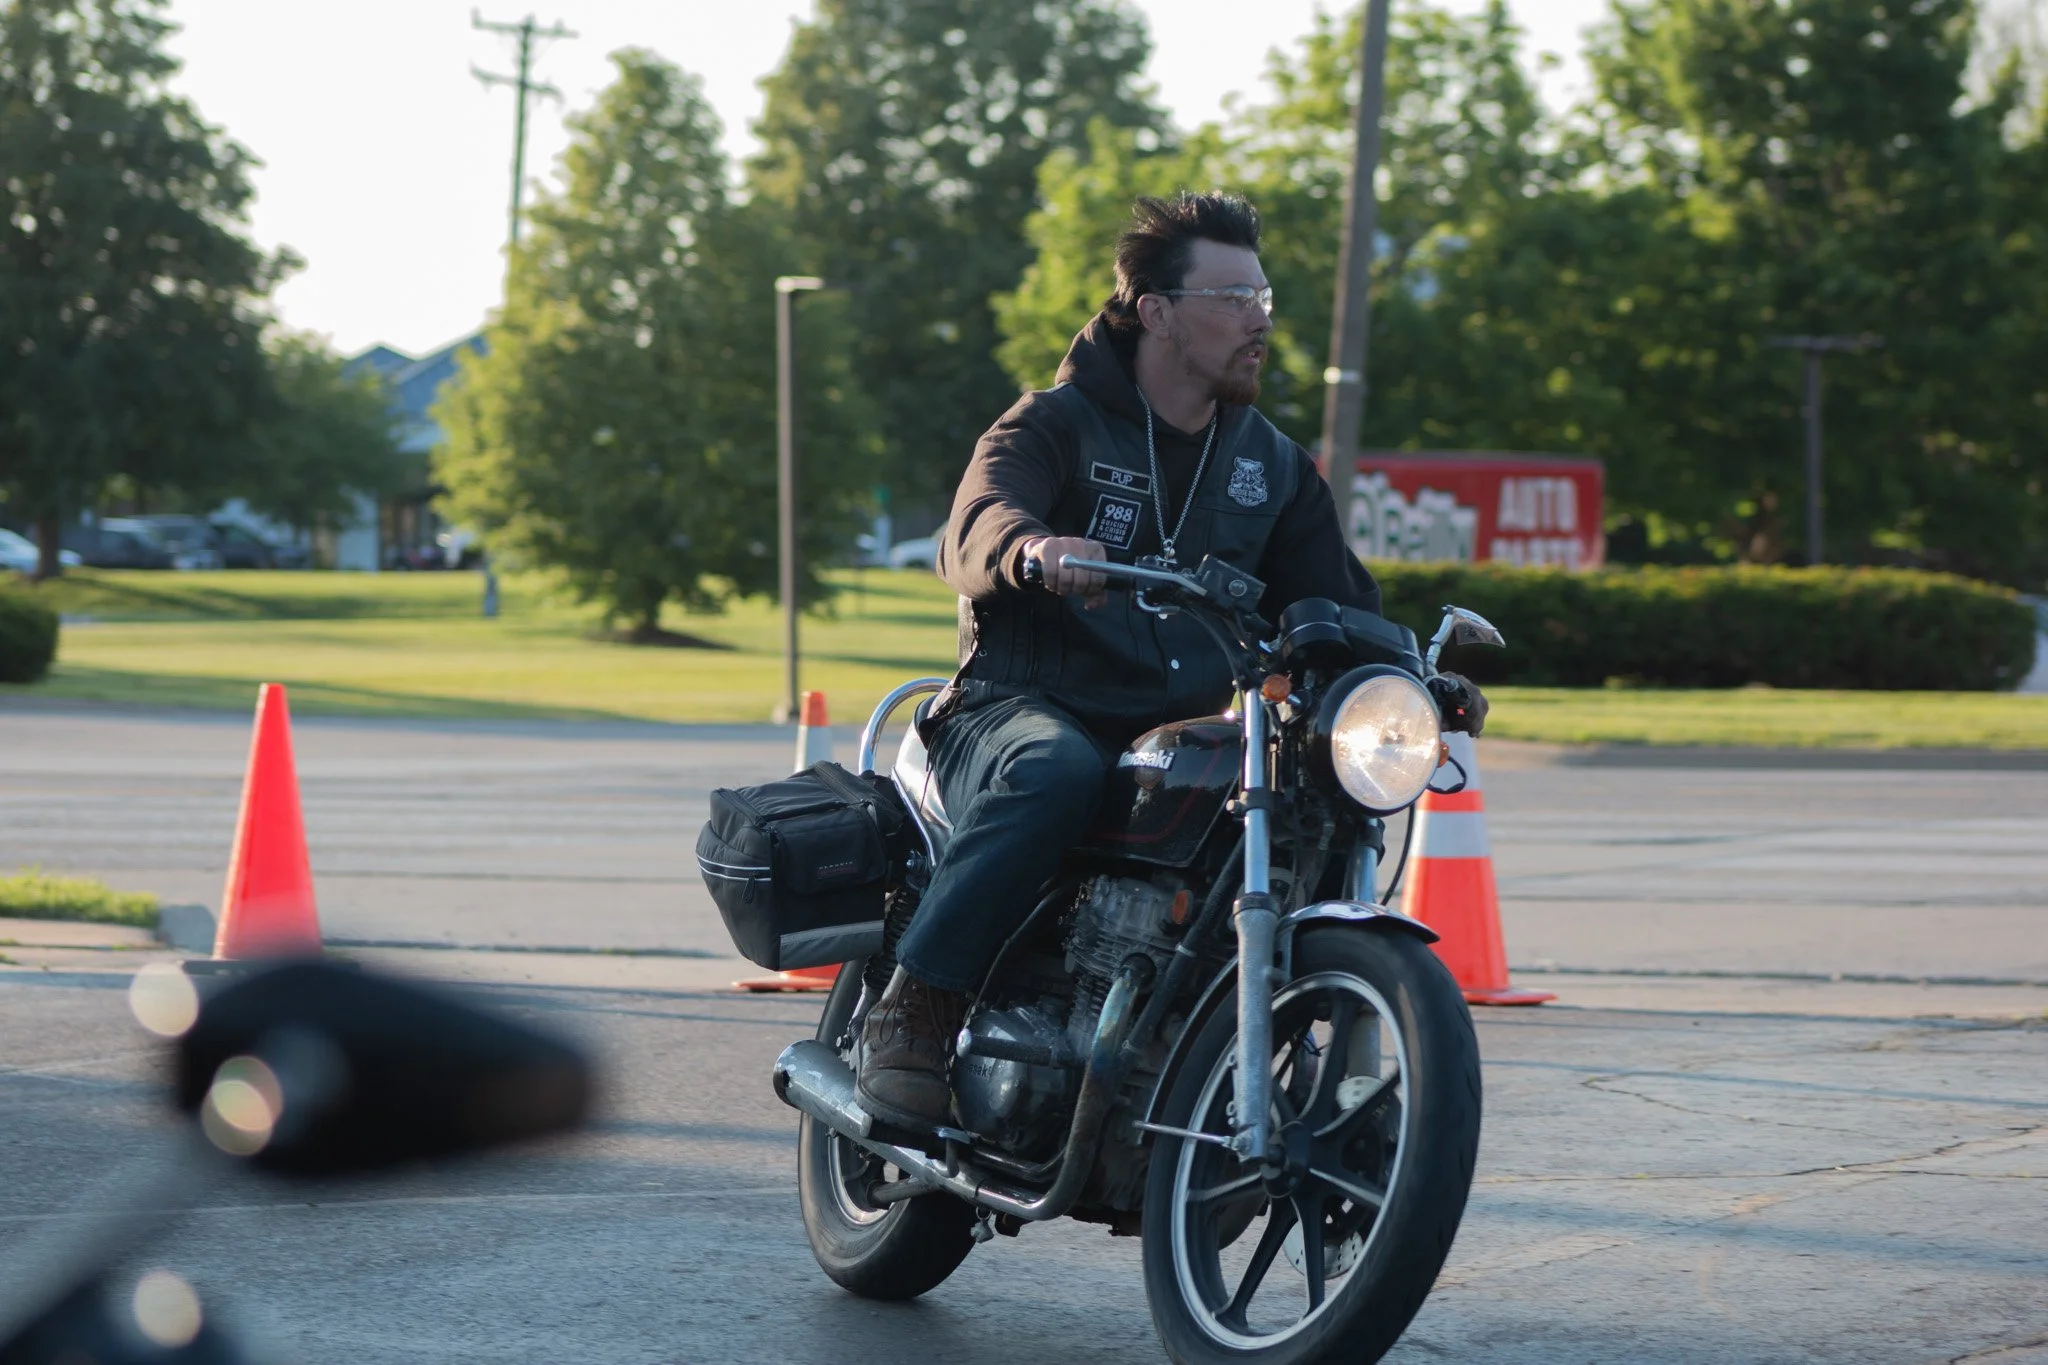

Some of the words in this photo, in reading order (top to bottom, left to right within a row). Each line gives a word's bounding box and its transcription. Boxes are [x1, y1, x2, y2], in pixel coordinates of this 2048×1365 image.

[1111, 471, 1133, 486] PUP
[1104, 503, 1133, 523] 988
[1100, 518, 1129, 530] SUICIDE
[1096, 531, 1124, 542] LIFELINE
[1104, 526, 1127, 536] CRISIS
